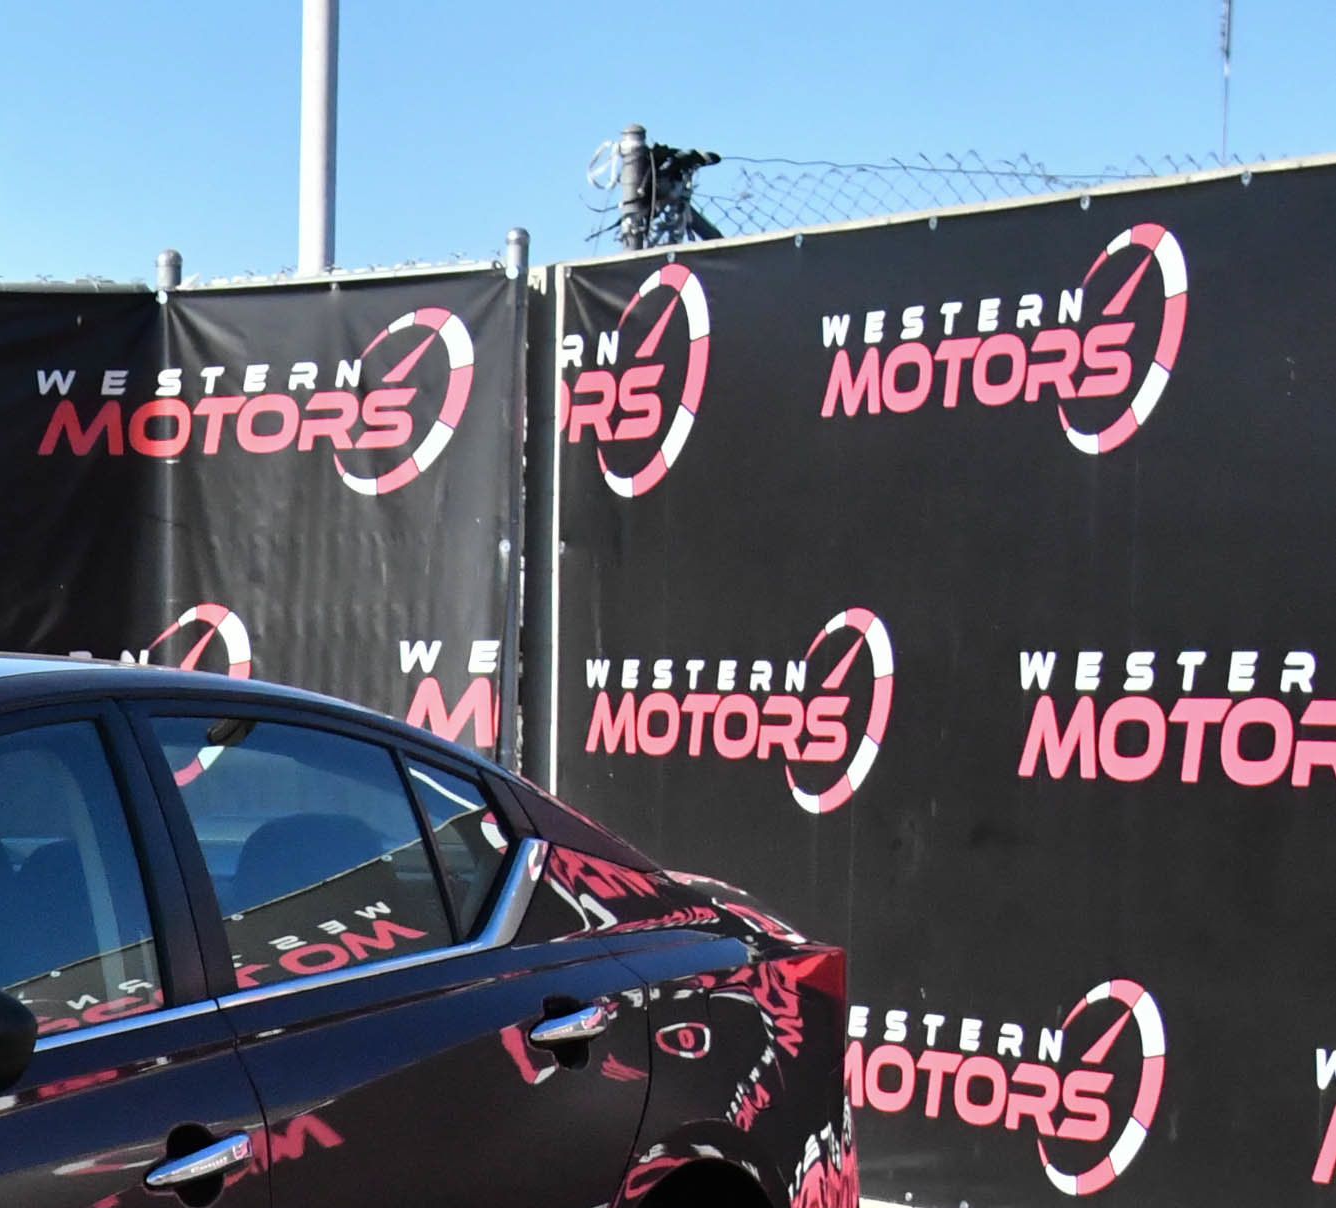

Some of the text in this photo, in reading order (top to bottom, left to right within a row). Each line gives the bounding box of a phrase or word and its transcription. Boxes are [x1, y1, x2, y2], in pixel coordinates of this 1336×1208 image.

[821, 286, 1084, 348] WESTERN
[36, 359, 362, 397] WESTERN
[820, 322, 1136, 418] MOTORS
[37, 387, 417, 457] MOTORS
[585, 659, 807, 692] WESTERN
[585, 691, 851, 762] MOTORS
